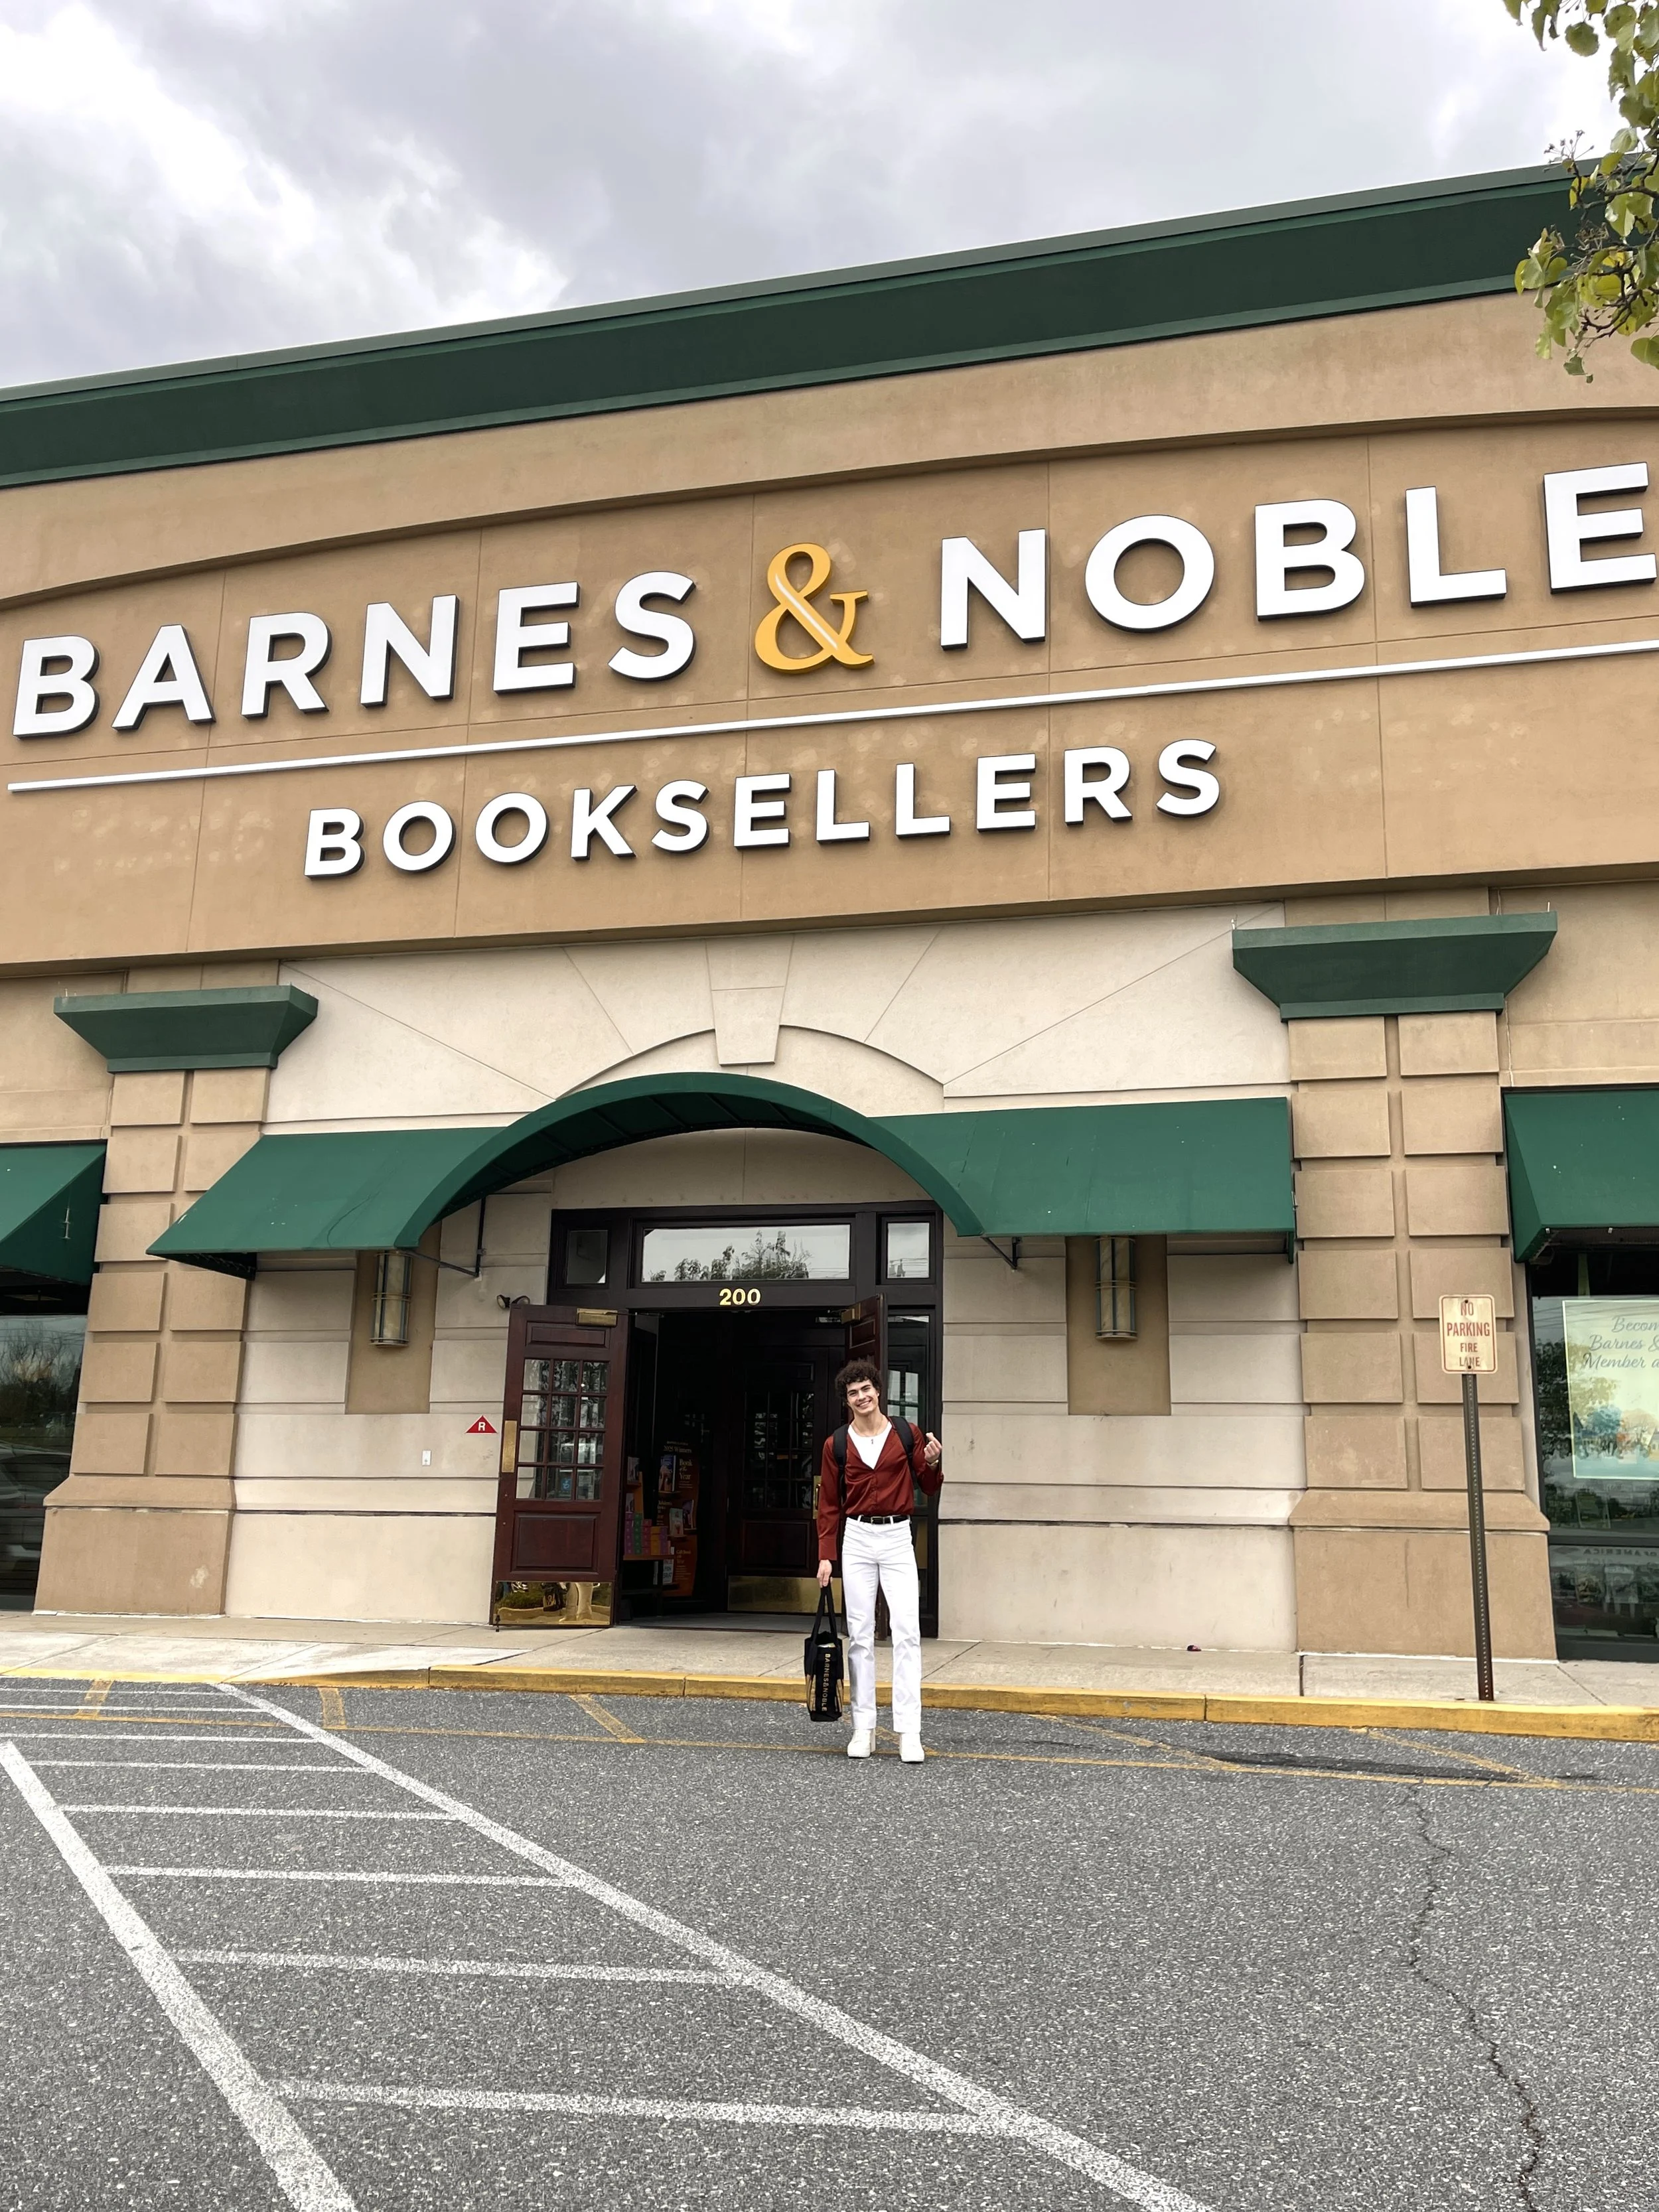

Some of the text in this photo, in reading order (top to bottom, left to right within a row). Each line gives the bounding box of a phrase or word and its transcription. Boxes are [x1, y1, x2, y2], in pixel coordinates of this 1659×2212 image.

[13, 462, 1658, 738] BARNES & NOBLE
[304, 738, 1220, 878] BOOKSELLERS
[719, 1288, 761, 1306] 200
[1461, 1302, 1474, 1316] NO
[1447, 1322, 1490, 1336] PARKING
[1460, 1343, 1478, 1352] FIRE
[1589, 1334, 1642, 1351] Barnes
[1459, 1357, 1480, 1367] LANE
[1583, 1353, 1646, 1370] Member
[478, 1421, 486, 1431] R
